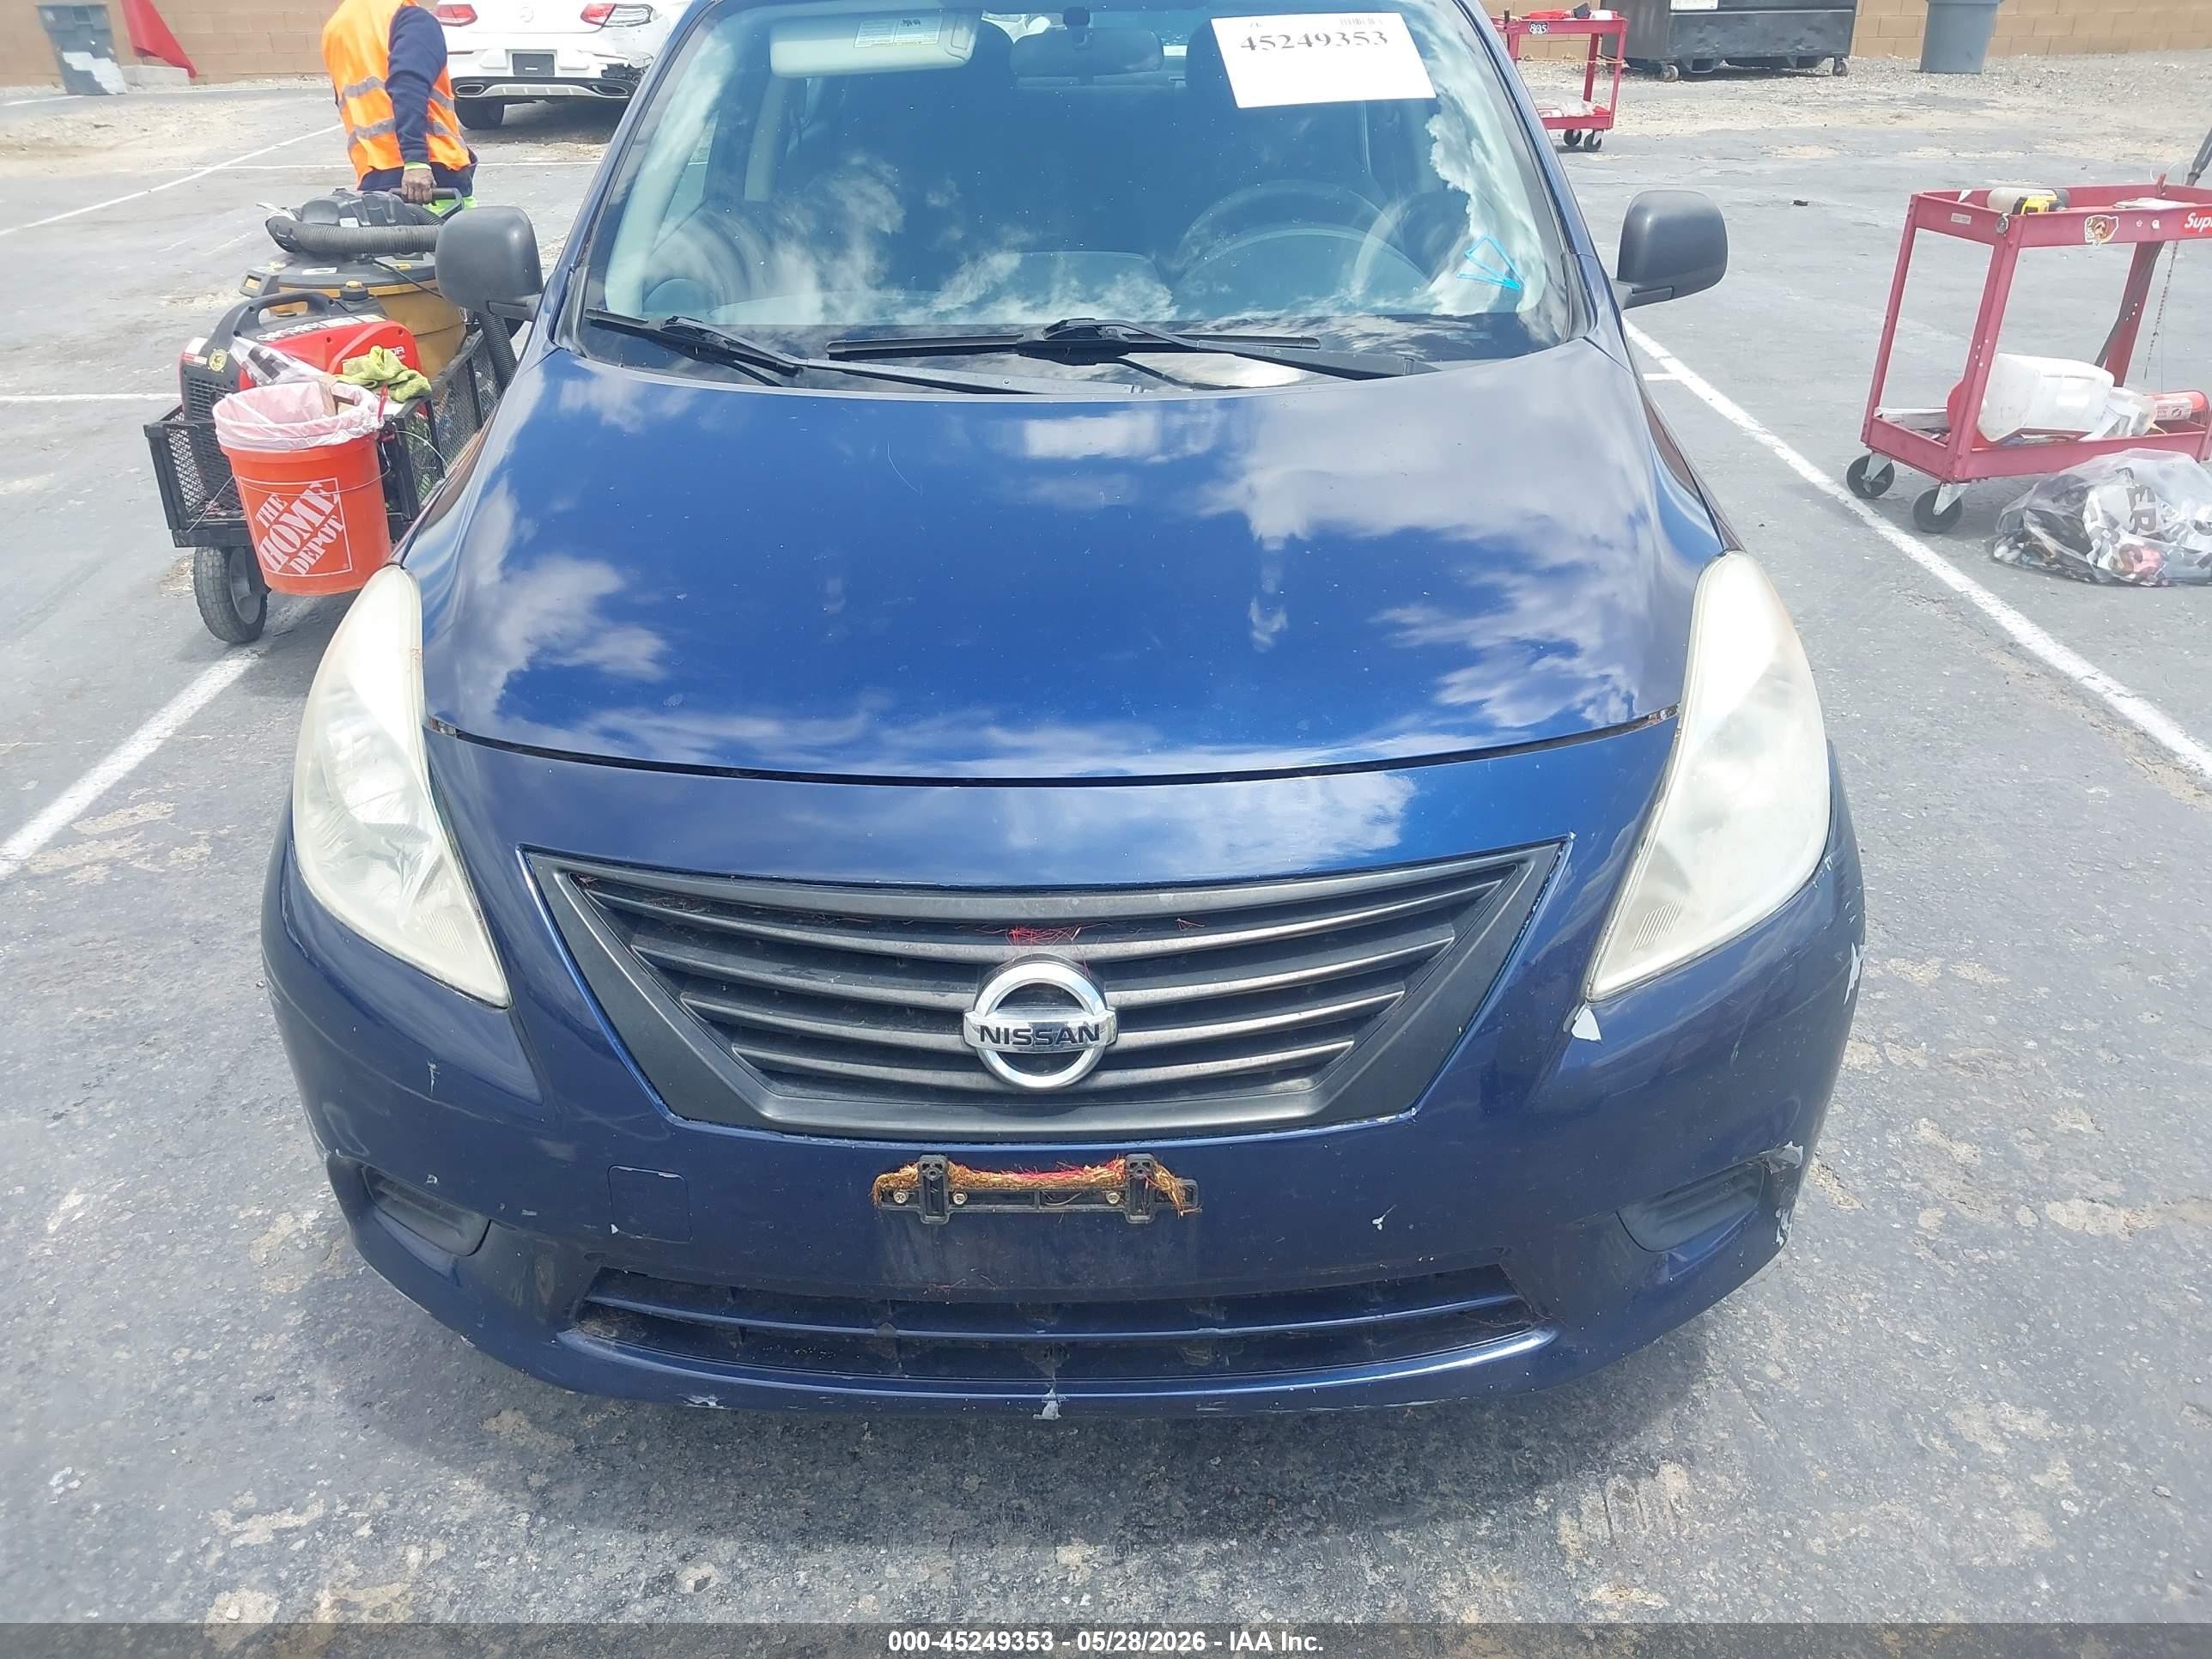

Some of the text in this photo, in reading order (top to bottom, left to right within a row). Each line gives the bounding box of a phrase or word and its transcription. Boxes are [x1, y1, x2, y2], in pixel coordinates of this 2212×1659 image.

[1240, 31, 1388, 51] 45249353
[2184, 212, 2212, 233] Sup
[255, 493, 289, 528] THE
[259, 482, 339, 572] HOME
[289, 515, 344, 575] DEPOT
[980, 1022, 1100, 1046] NISSAN
